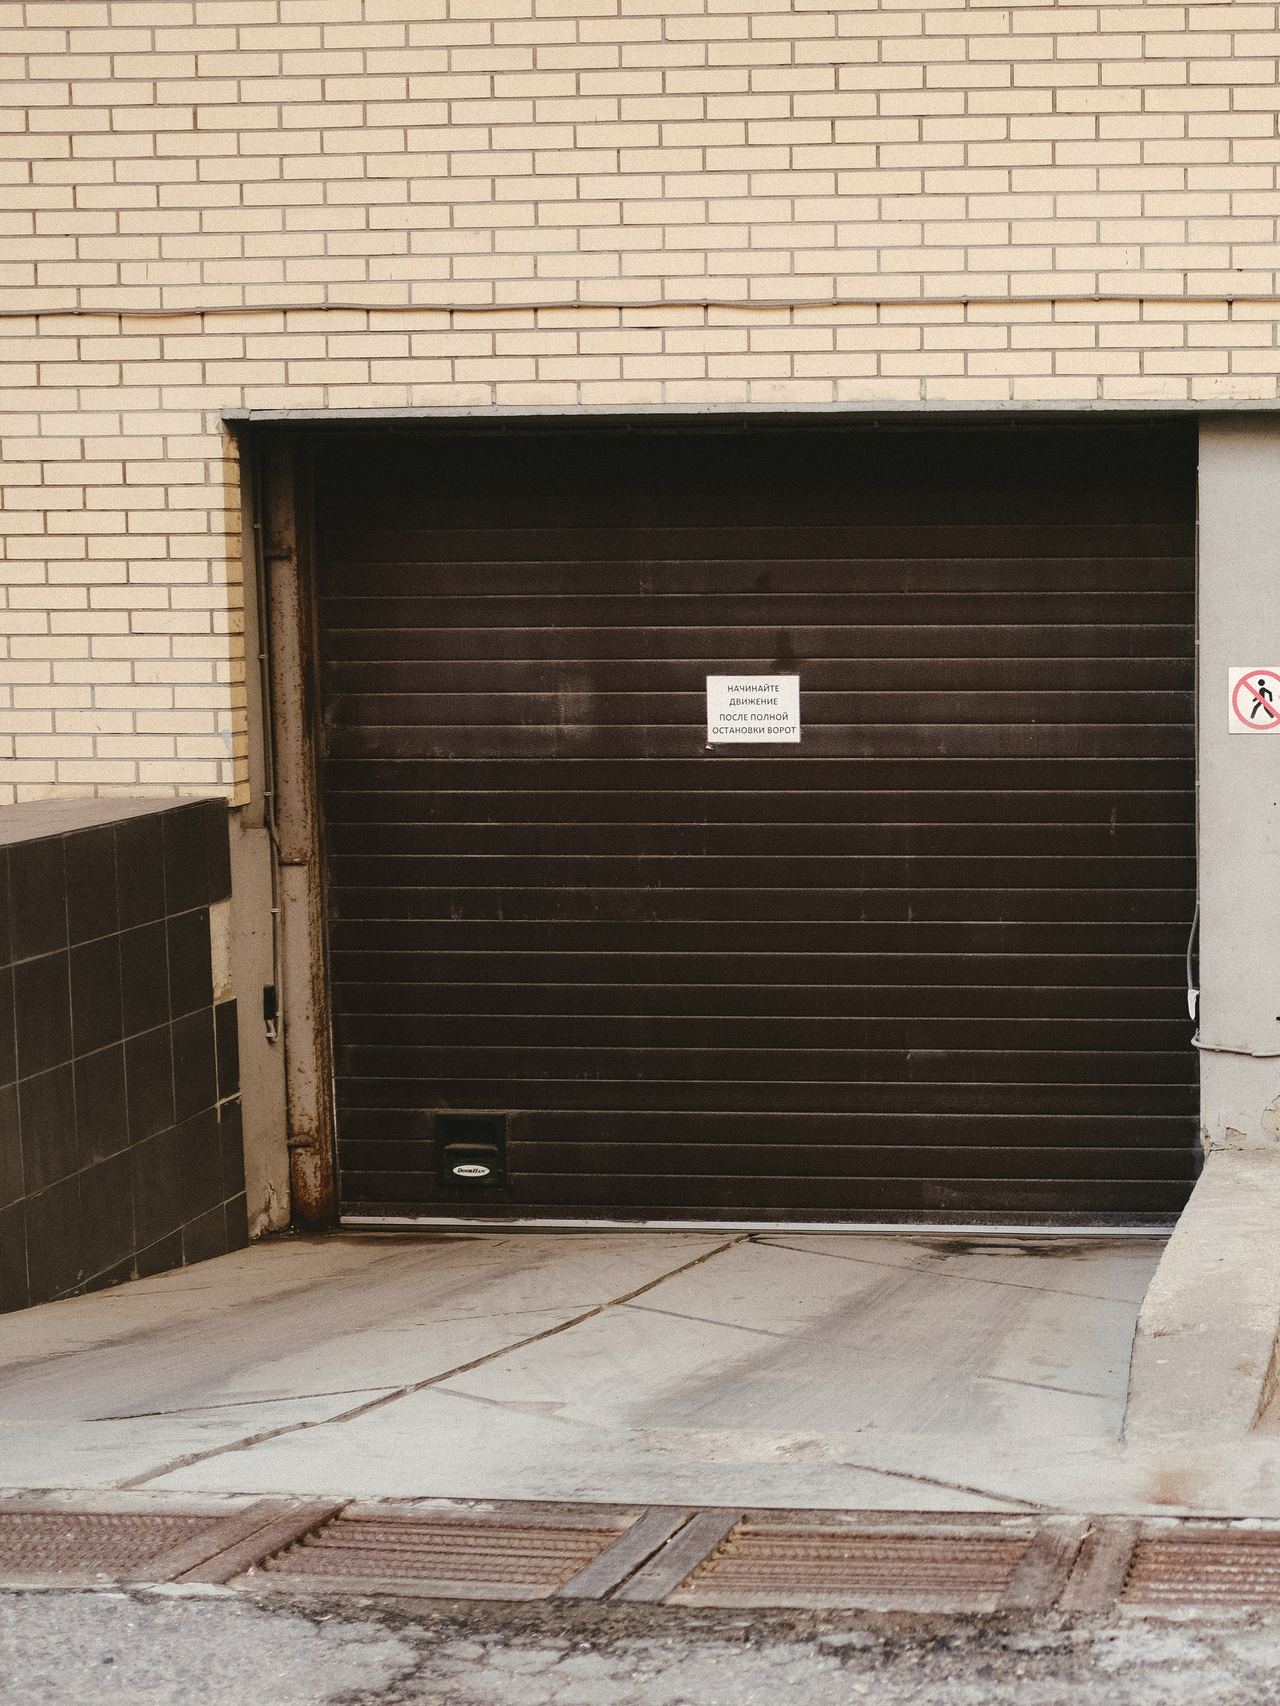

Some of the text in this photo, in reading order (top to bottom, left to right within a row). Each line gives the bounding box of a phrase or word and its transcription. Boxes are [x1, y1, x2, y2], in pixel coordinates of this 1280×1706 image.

[727, 684, 780, 692] НАЧИНАЙТЕ
[729, 698, 778, 706] ДВИЖЕНИЕ
[719, 712, 789, 721] ПОСЛЕ ПОЛНОЙ
[712, 726, 796, 734] ОСТАНОВКИ ВОРОТ
